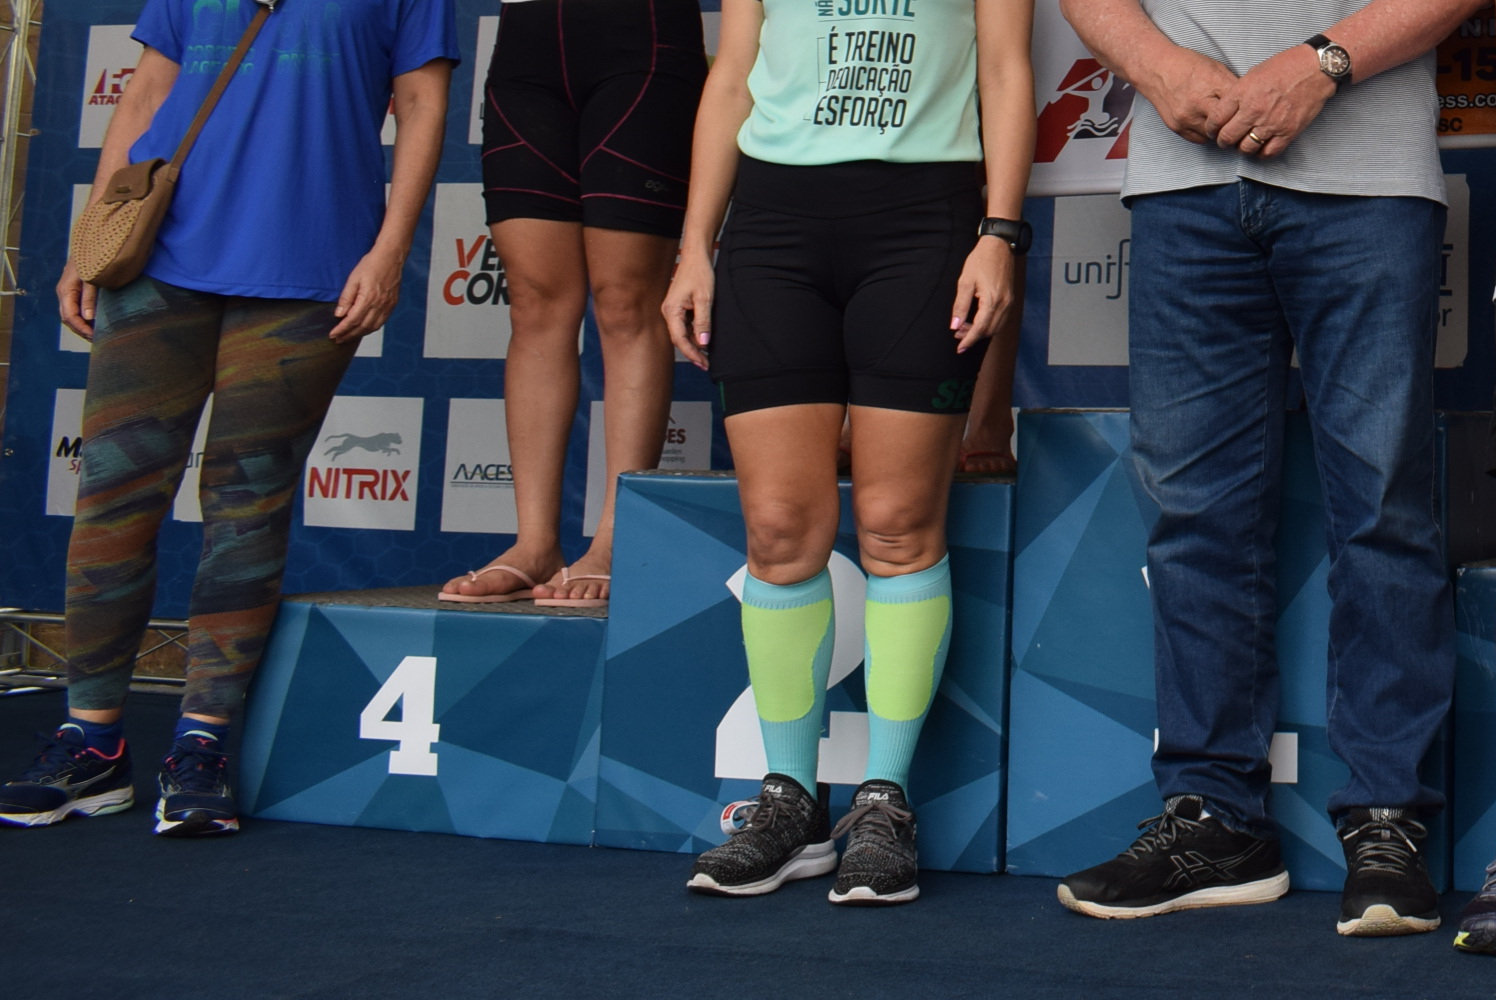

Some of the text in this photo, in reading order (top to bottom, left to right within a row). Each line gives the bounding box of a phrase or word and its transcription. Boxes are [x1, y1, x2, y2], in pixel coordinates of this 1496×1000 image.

[828, 26, 916, 65] É TREINO
[826, 64, 912, 97] DEDICAÇÃO
[814, 95, 907, 135] ESFORÇO
[308, 466, 411, 501] NITRIX
[359, 656, 440, 776] 4
[764, 784, 783, 794] FILA
[867, 792, 889, 801] FILA
